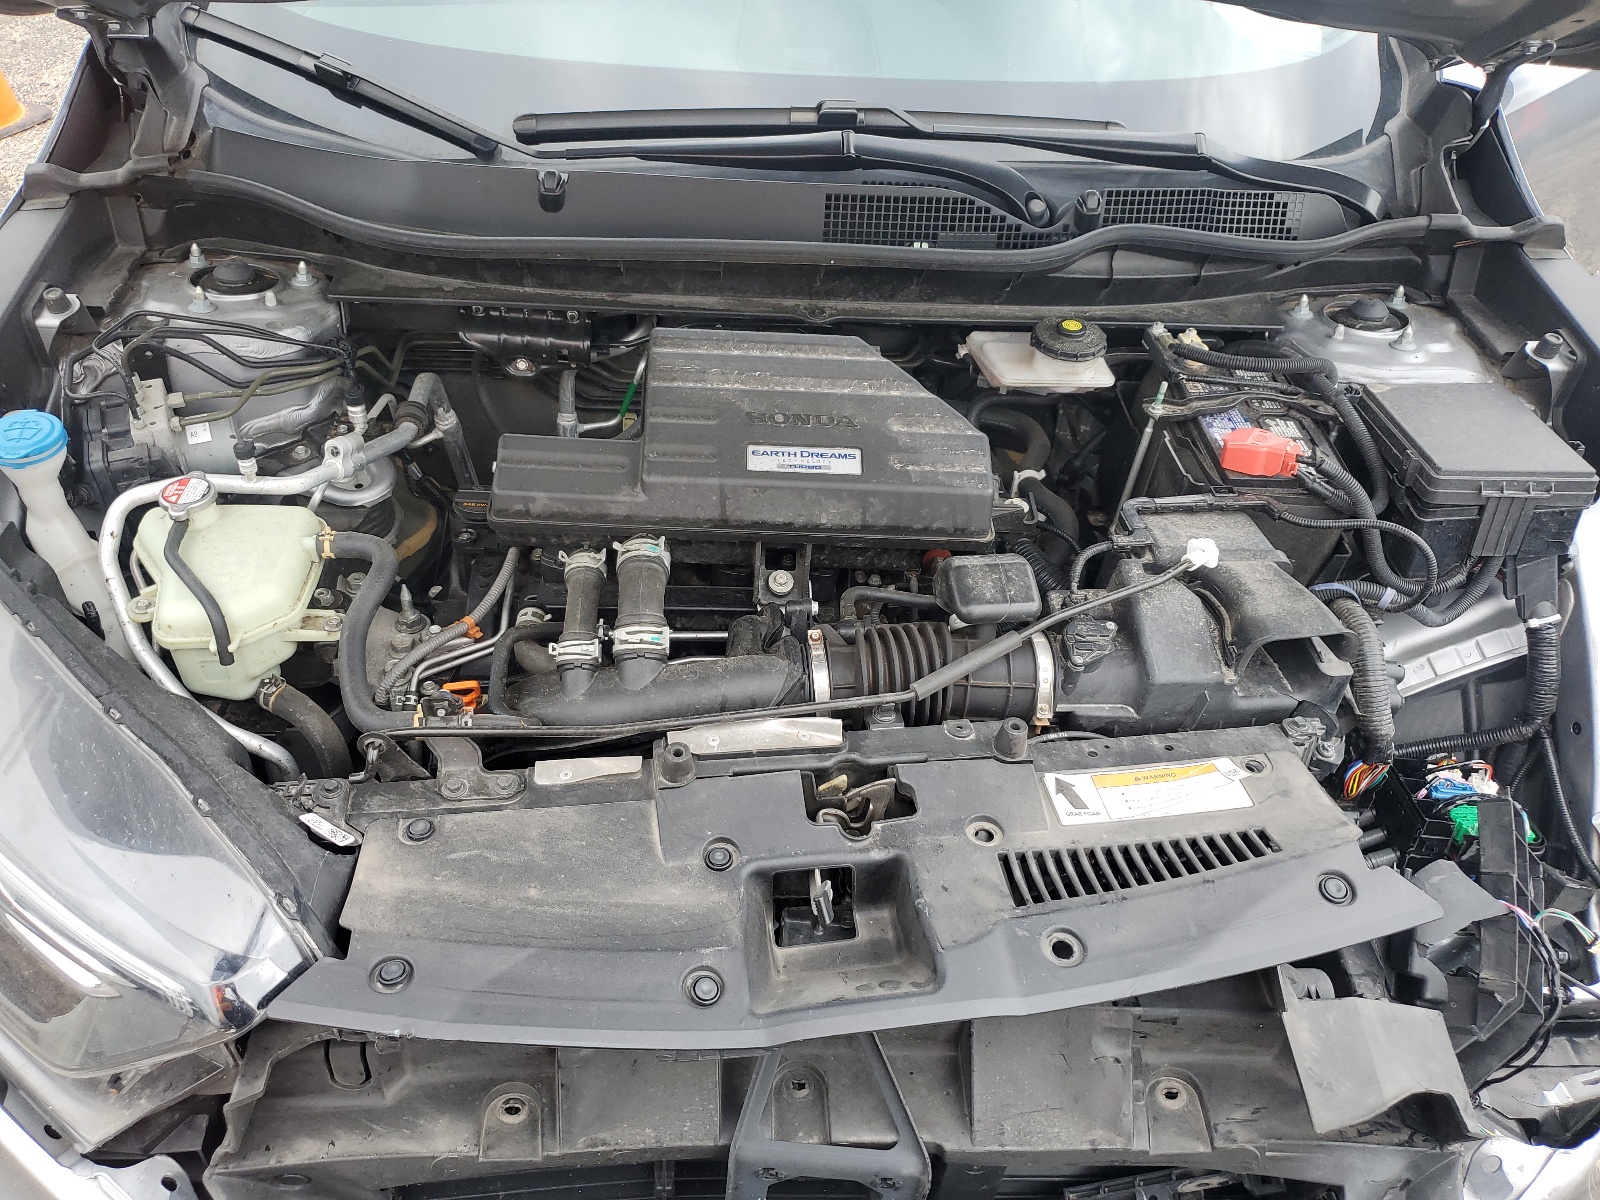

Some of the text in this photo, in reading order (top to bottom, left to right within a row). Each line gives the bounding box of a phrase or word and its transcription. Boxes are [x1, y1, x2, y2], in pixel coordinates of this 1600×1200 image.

[745, 411, 860, 428] HONDA
[751, 449, 857, 460] EARTH DREAMS
[1142, 772, 1177, 781] WARNING
